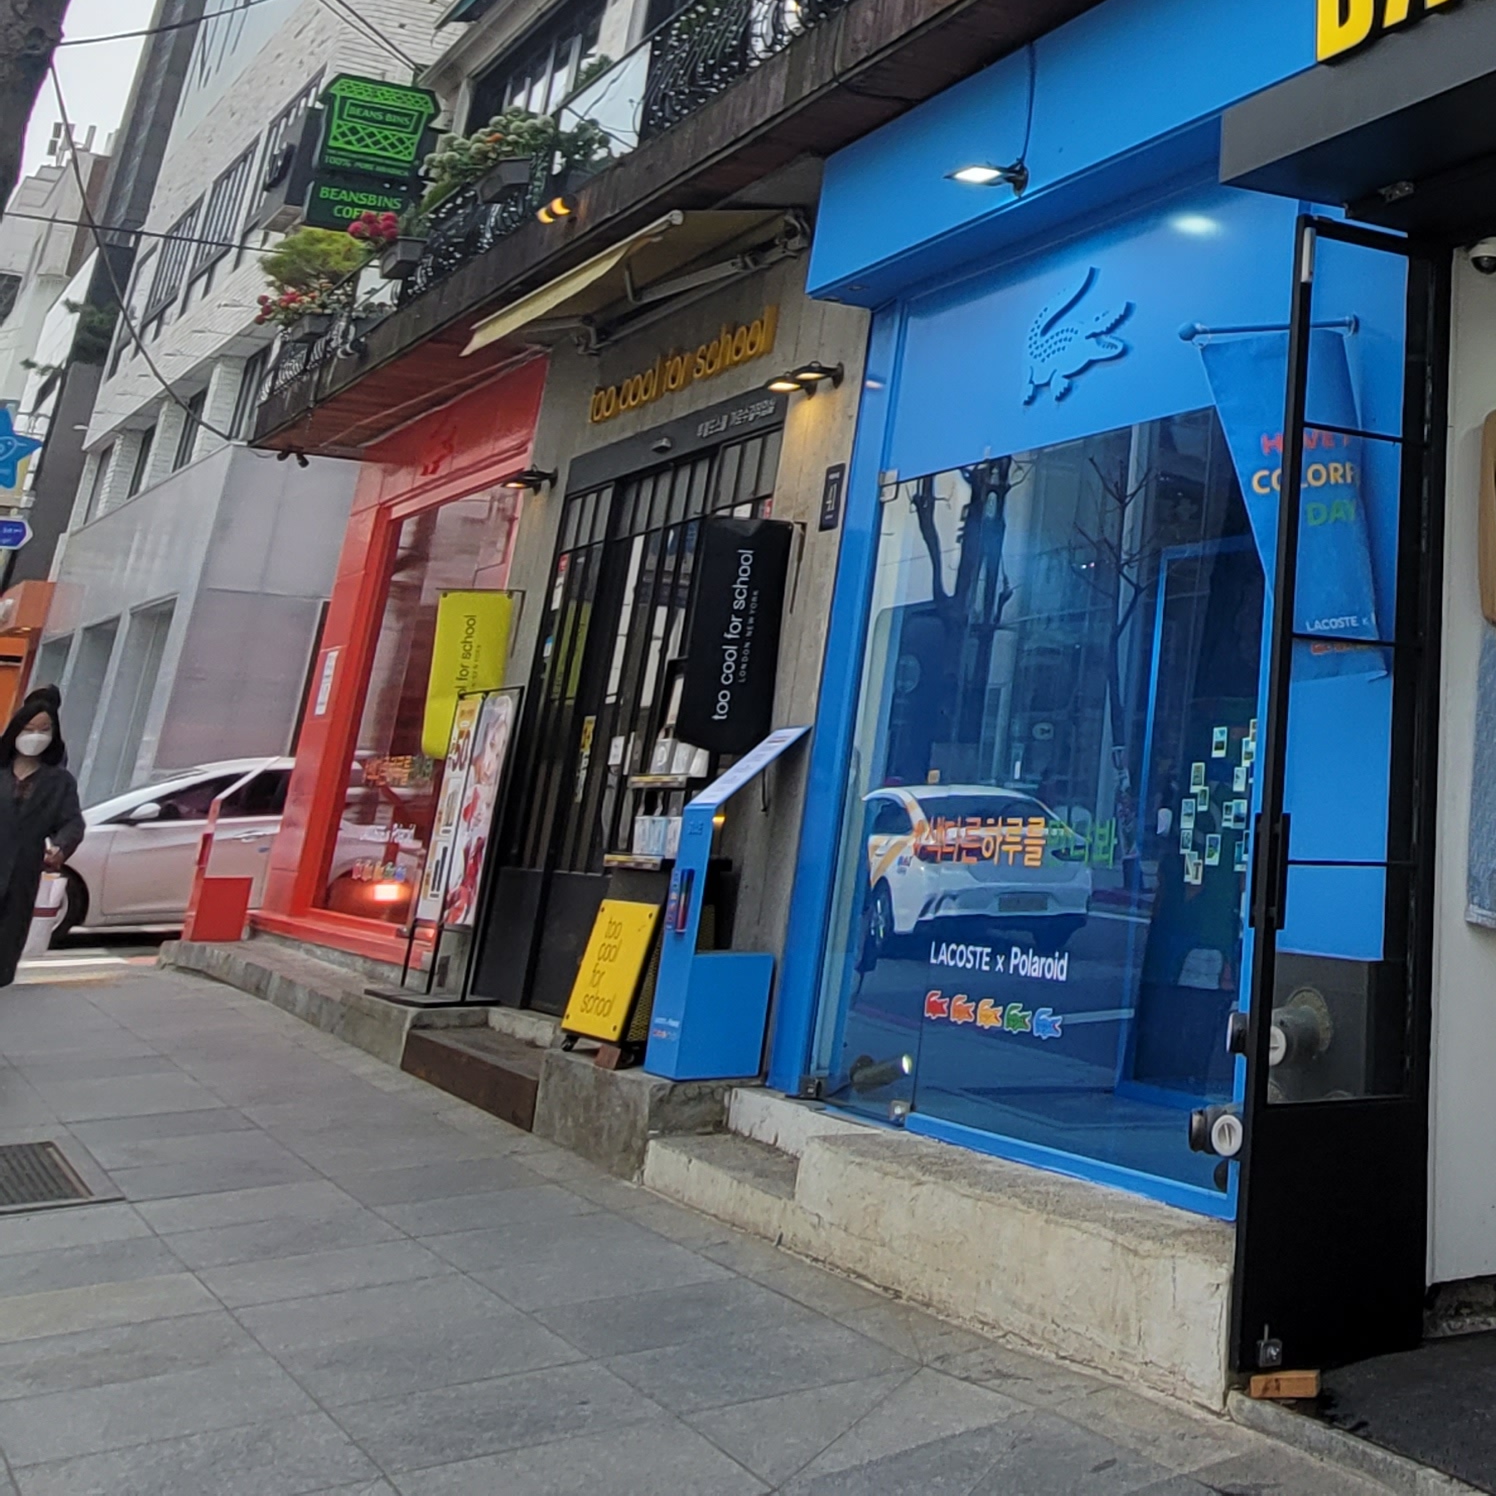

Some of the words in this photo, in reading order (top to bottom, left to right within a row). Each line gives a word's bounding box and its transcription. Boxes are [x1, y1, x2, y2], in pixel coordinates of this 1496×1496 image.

[349, 105, 383, 121] BEANS
[319, 186, 403, 210] BEANSBINS
[588, 385, 619, 423] too
[620, 356, 663, 410] cool
[663, 348, 691, 392] for
[693, 304, 779, 379] school
[1261, 429, 1335, 455] HVE
[731, 549, 755, 610] school
[723, 616, 743, 640] for
[1305, 616, 1359, 631] LACOSTE
[460, 615, 477, 660] school
[738, 642, 751, 683] LONDON
[745, 615, 755, 638] NEW
[457, 663, 470, 682] for
[721, 645, 739, 685] cool
[711, 689, 731, 721] too
[605, 916, 622, 940] too
[597, 939, 623, 962] cool
[929, 941, 992, 971] LACOSTE
[995, 954, 1005, 972] x
[1009, 946, 1069, 982] Polaroid
[590, 962, 606, 988] for
[580, 991, 617, 1018] school
